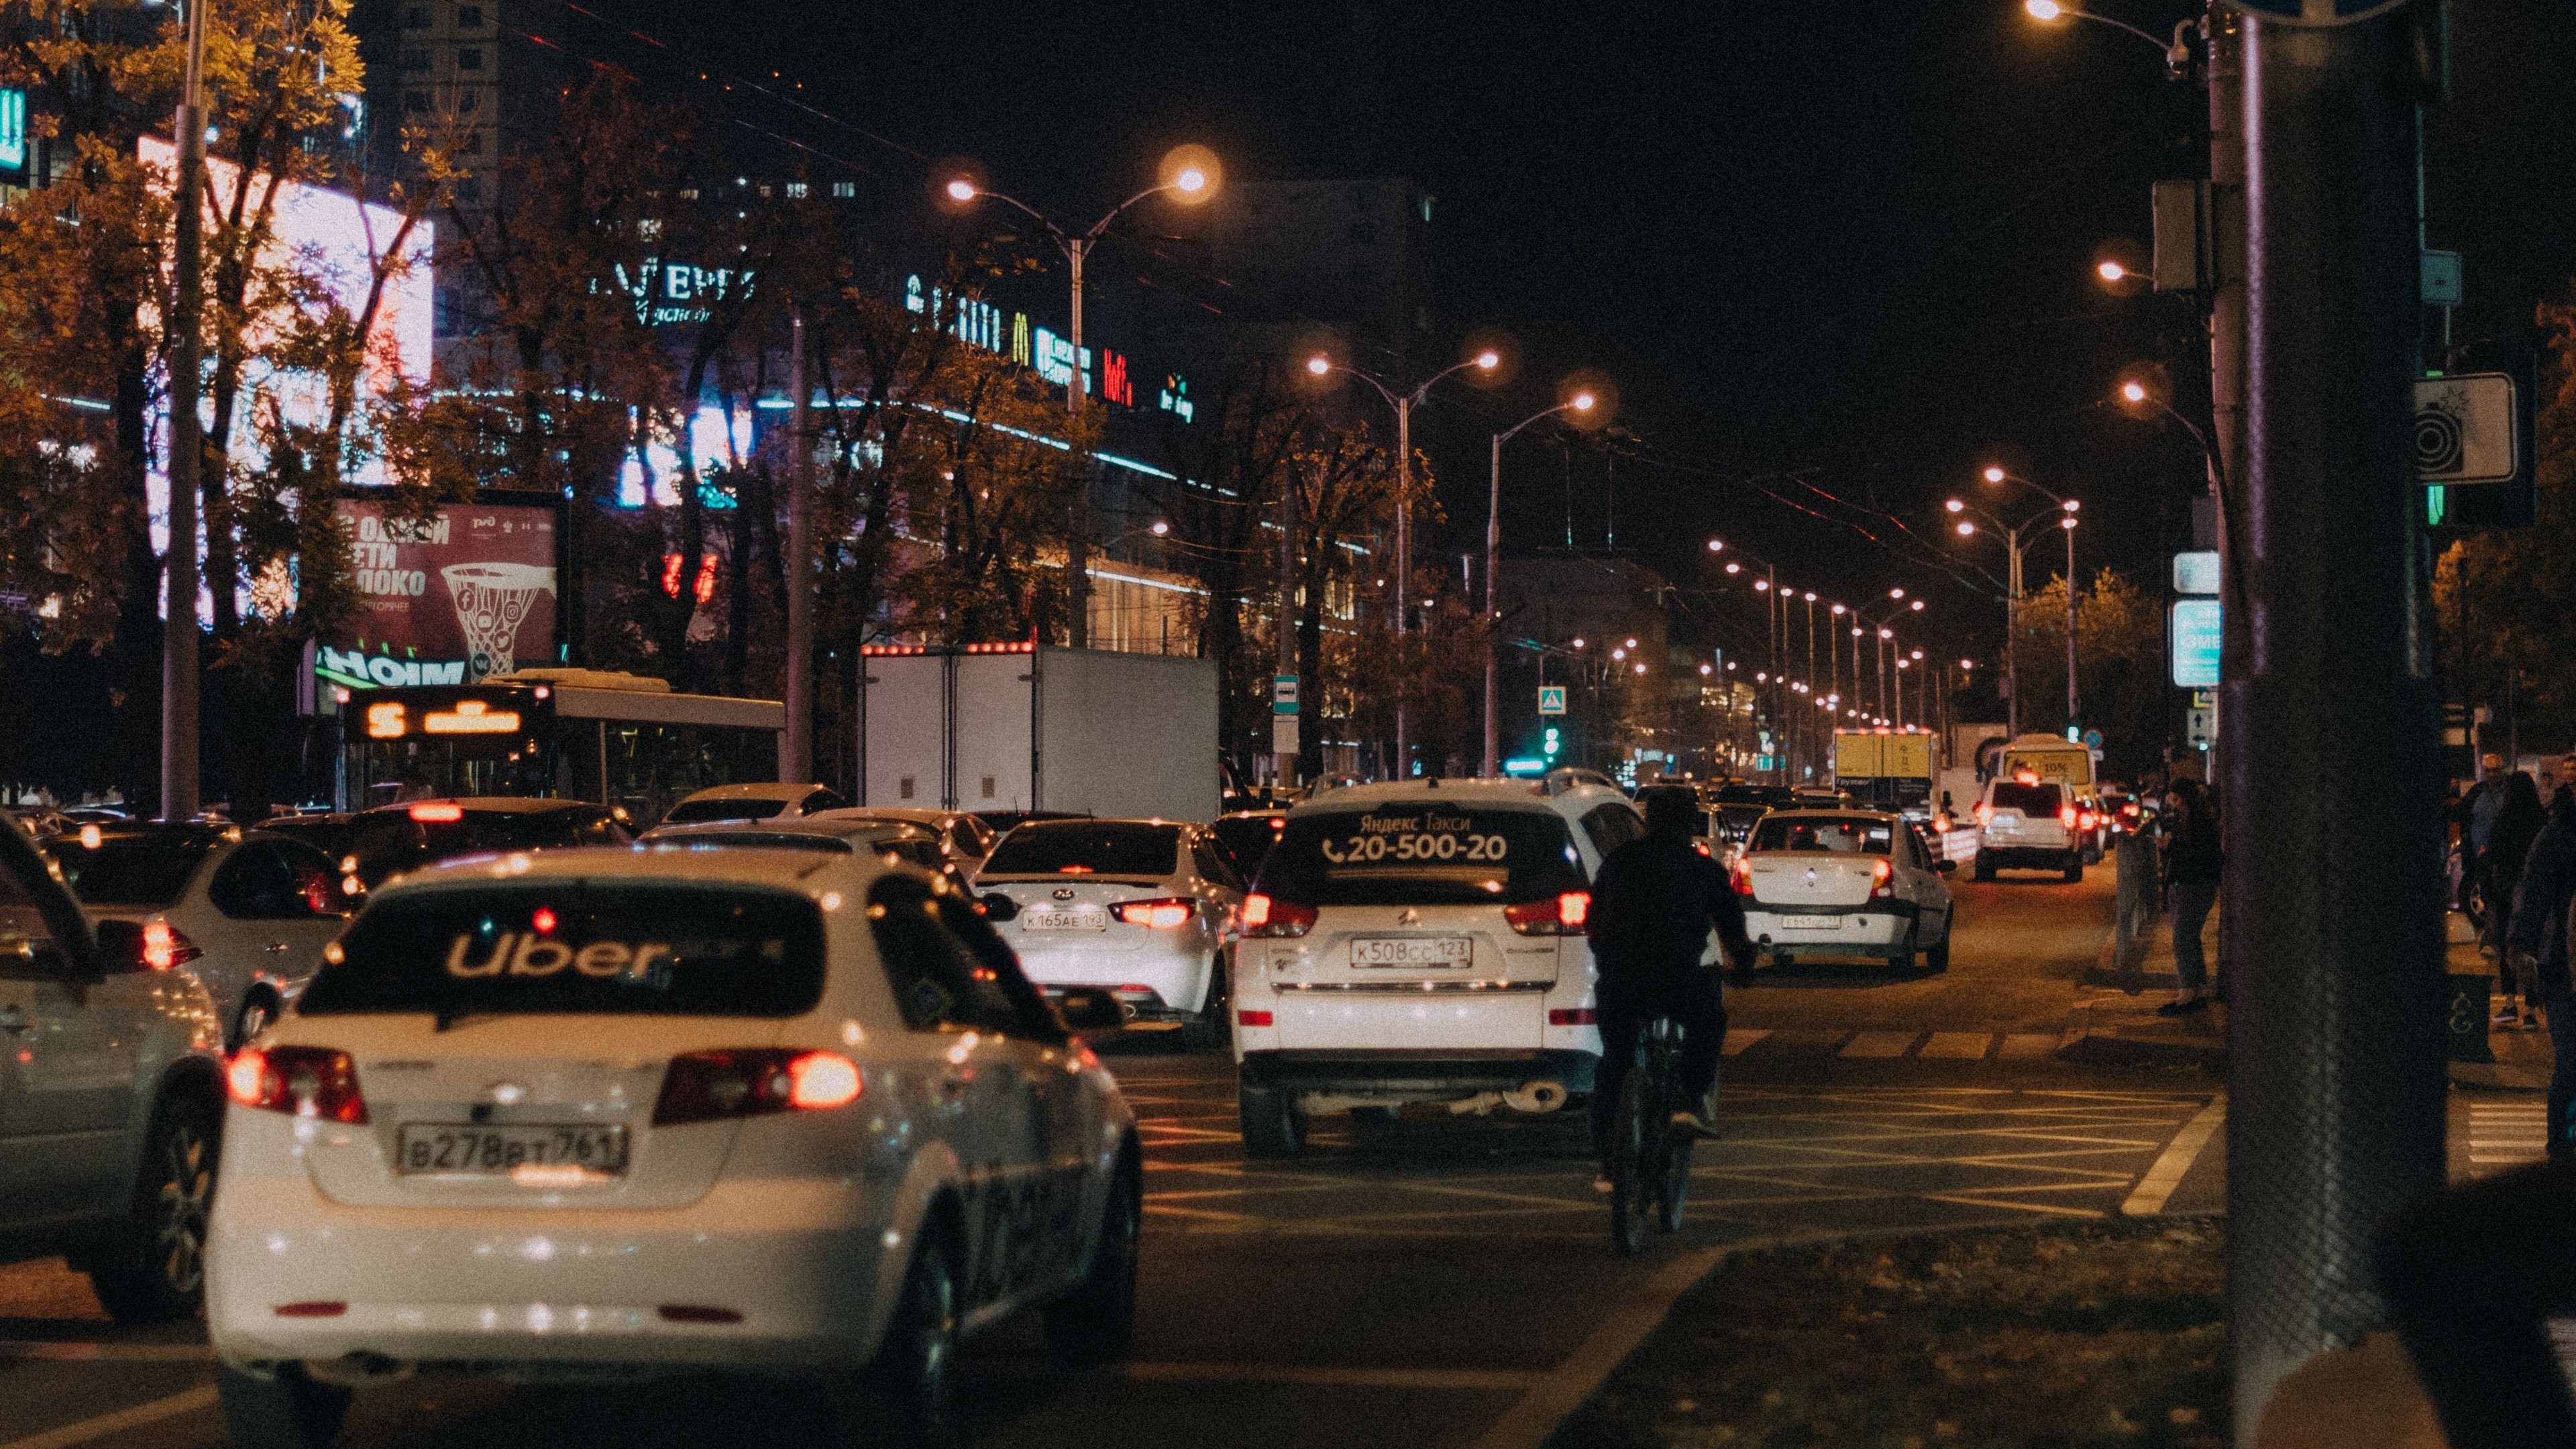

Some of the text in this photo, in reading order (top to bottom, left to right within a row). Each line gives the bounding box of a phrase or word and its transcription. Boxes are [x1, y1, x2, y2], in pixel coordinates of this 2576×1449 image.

[346, 542, 397, 569] ЕТИ
[1360, 812, 1471, 833] Яндекс Такси
[1347, 833, 1507, 862] 20-500-20
[445, 932, 672, 979] Uber
